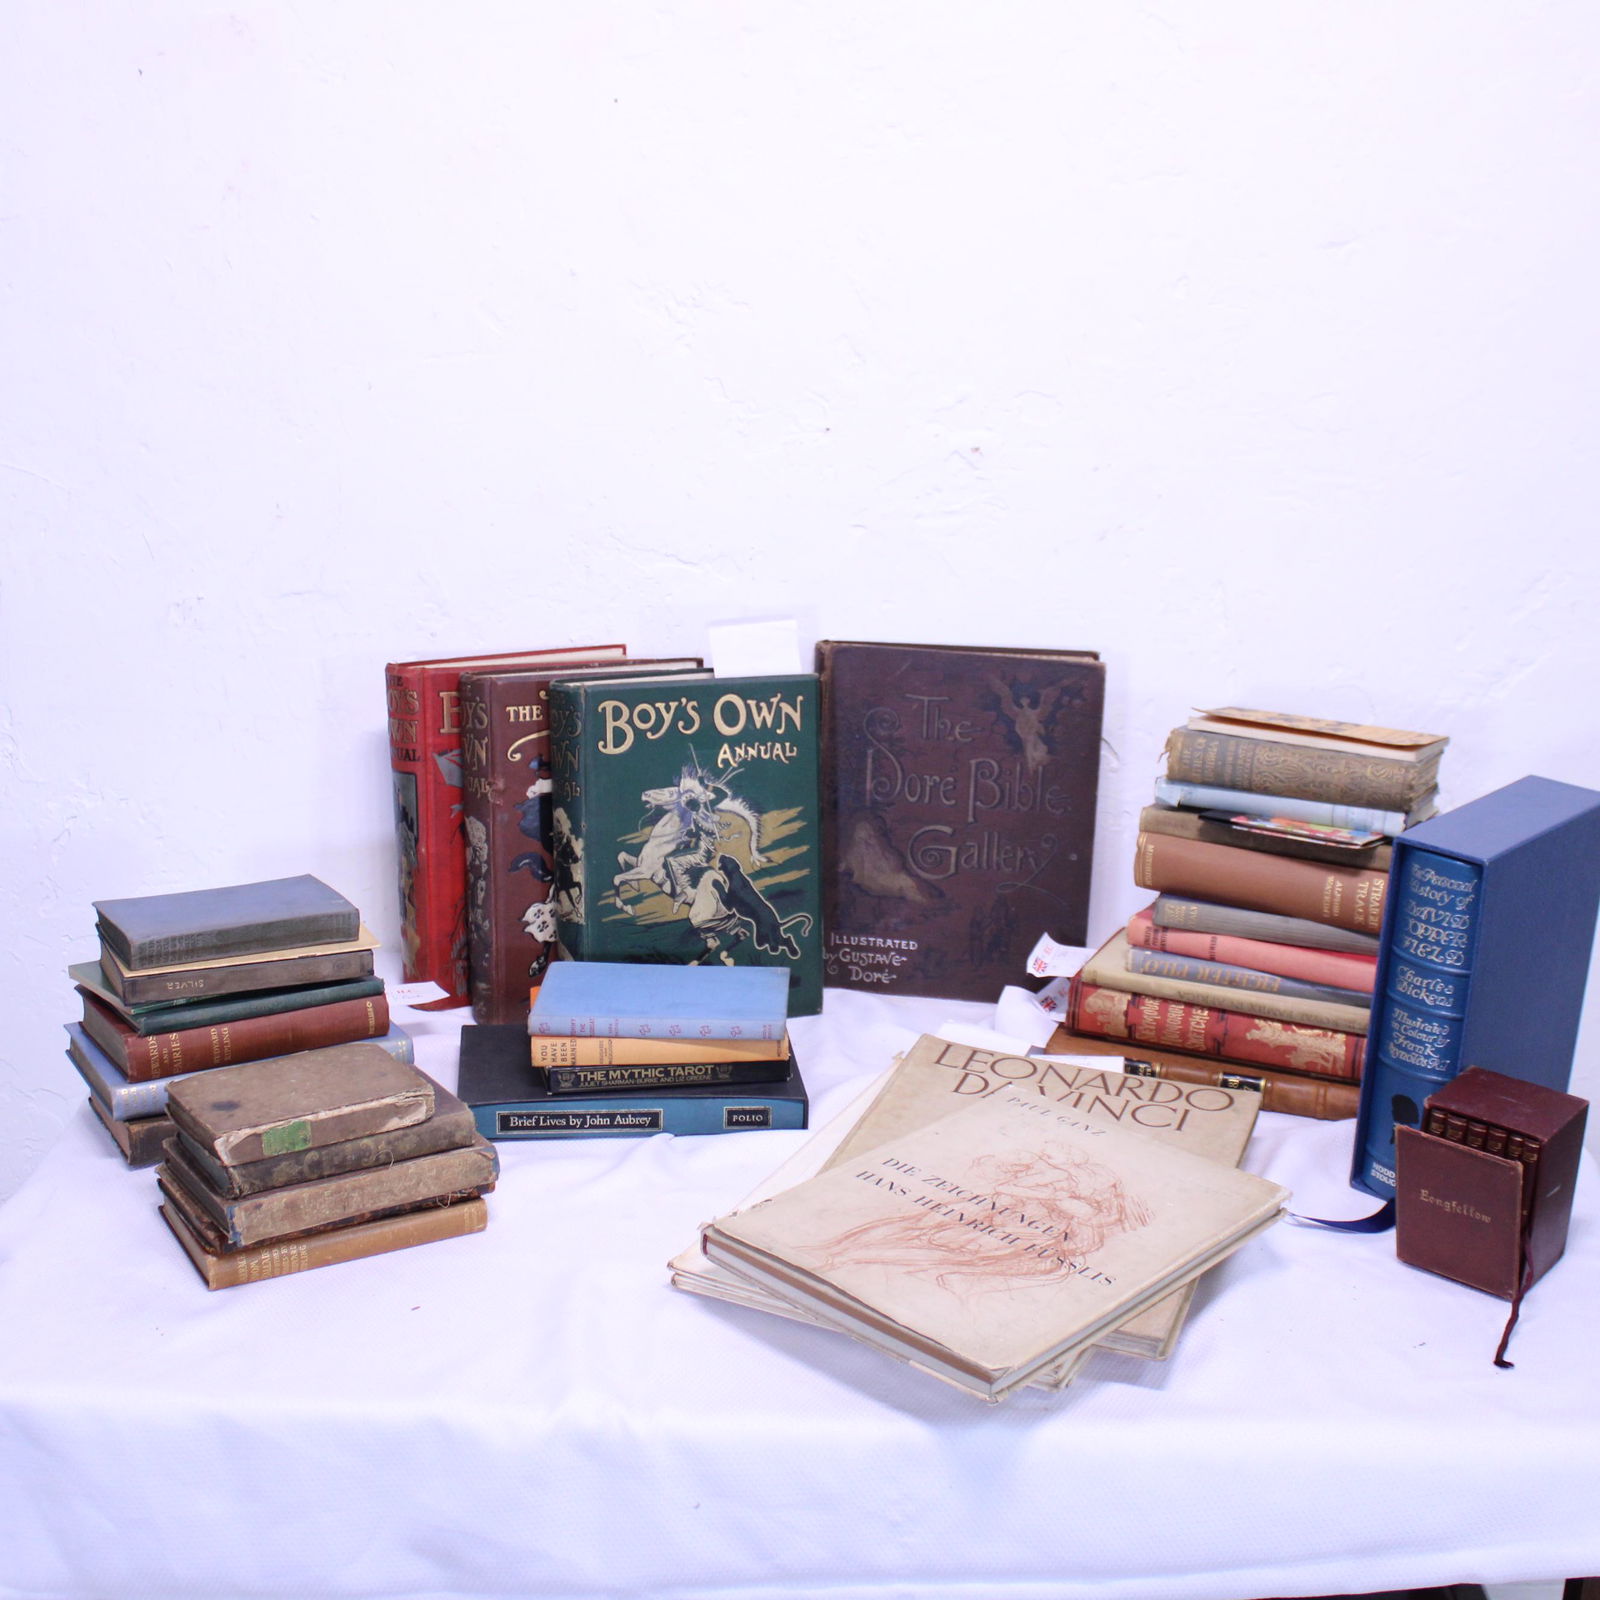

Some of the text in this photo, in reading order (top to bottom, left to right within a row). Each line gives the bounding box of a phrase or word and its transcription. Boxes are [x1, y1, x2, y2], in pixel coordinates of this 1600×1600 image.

[505, 704, 544, 722] THE
[905, 693, 984, 742] The
[717, 742, 798, 769] ANNUAL
[908, 825, 1062, 896] Gallery
[1354, 880, 1370, 926] TRACK
[1455, 894, 1475, 911] of
[830, 932, 919, 950] ILLUSTRATED
[166, 979, 205, 990] SILVER
[1396, 979, 1455, 1007] Dickens
[1398, 965, 1455, 995] Charles
[1391, 1008, 1450, 1036] Illustrated
[147, 1035, 160, 1079] REWARDS
[169, 1032, 182, 1074] FAIRIES
[210, 1027, 221, 1066] RUDYARD
[221, 1027, 232, 1061] KIPLING
[540, 1044, 548, 1063] YOU
[550, 1042, 558, 1063] HAVE
[560, 1041, 568, 1063] BEEN
[569, 1038, 577, 1066] WARNED
[1392, 1032, 1440, 1058] Frank
[577, 1064, 715, 1082] THE MYTHIC TAROT
[578, 1079, 601, 1088] JULIET
[660, 1076, 674, 1084] AND
[686, 1074, 713, 1082] GREENE
[933, 1043, 1235, 1112] LEONARDO
[509, 1114, 652, 1128] Brief Lives by John Aubrey
[732, 1114, 763, 1122] FOLIO
[1007, 1096, 1106, 1136] PAUL GANZ
[1372, 1162, 1396, 1179] HODD
[855, 1170, 912, 1196] HANS
[913, 1195, 1020, 1246] HEINRICH
[881, 1157, 1071, 1243] DIE ZEICHNUNGEN
[1419, 1189, 1492, 1225] Longfellow
